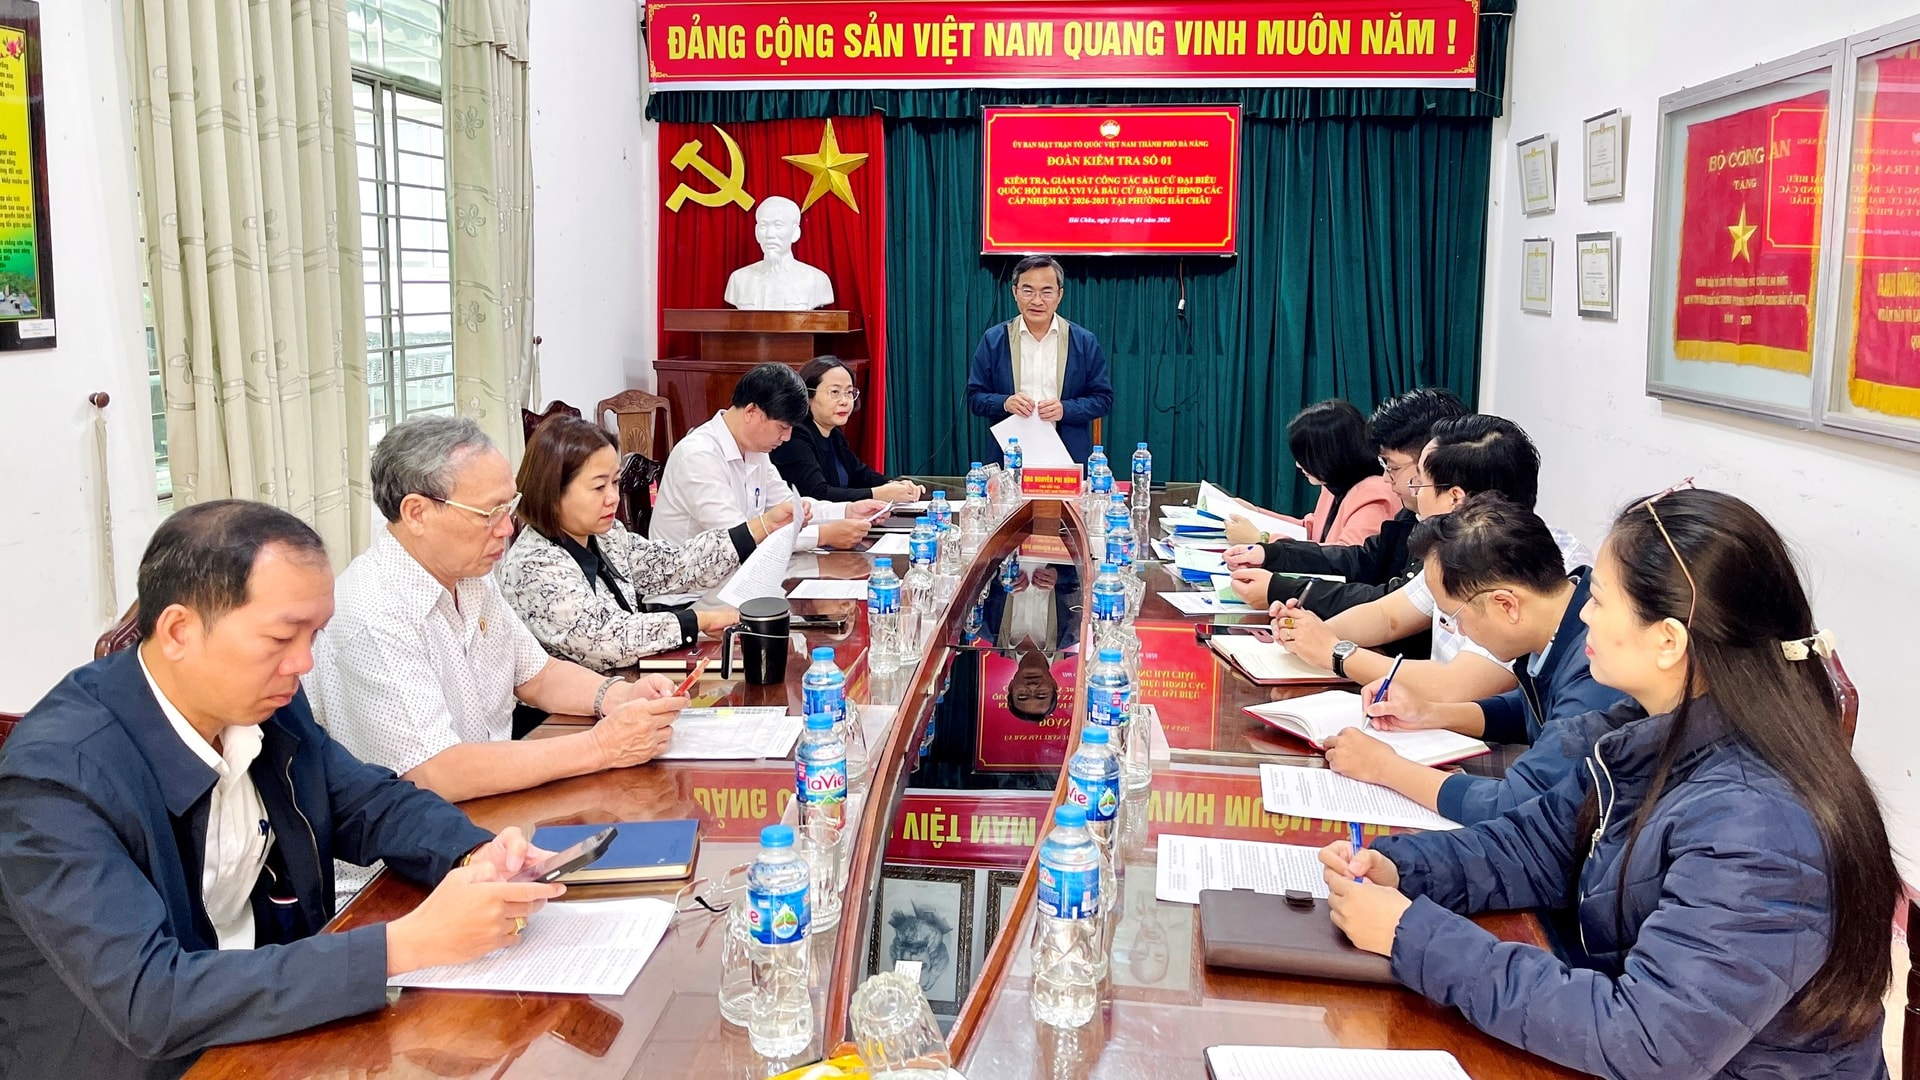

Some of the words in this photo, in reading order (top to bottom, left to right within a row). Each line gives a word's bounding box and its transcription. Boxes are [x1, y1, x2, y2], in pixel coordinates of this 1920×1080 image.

[667, 13, 746, 60] ĐẢNG
[755, 17, 834, 66] CỘNG
[844, 11, 904, 59] SẢN
[913, 15, 975, 65] VIỆT
[984, 22, 1053, 58] NAM
[1063, 20, 1165, 60] QUANG
[1174, 19, 1247, 56] VINH
[1256, 12, 1350, 56] MUÔN
[1360, 11, 1435, 56] NĂM
[1446, 18, 1457, 55] !
[1023, 141, 1037, 149] BAN
[1084, 140, 1103, 149] QUỐC
[1104, 140, 1120, 149] VIỆT
[1138, 140, 1162, 148] THÀNH
[1728, 145, 1765, 168] CÔNG
[1768, 139, 1791, 161] AN
[1047, 154, 1080, 166] ĐOÀN
[1083, 153, 1114, 166] KIỂM
[1117, 156, 1141, 166] TRA
[1142, 153, 1158, 166] SỐ
[1160, 156, 1172, 166] 01
[1004, 175, 1027, 185] KIỂM
[1029, 177, 1050, 185] TRA,
[1051, 176, 1075, 185] GIÁM
[1076, 176, 1093, 185] SÁT
[1095, 175, 1121, 184] CÔNG
[1122, 175, 1141, 184] TÁC
[1177, 176, 1194, 186] ĐẠI
[997, 186, 1023, 196] QUỐC
[1024, 186, 1041, 196] HỘI
[1042, 185, 1068, 195] KHÓA
[1069, 187, 1085, 195] XVI
[1087, 186, 1099, 195] VÀ
[1136, 187, 1152, 196] ĐẠI
[1203, 185, 1224, 194] CÁC
[1027, 197, 1056, 206] NHIỆM
[1072, 197, 1109, 205] 2026-2031
[1111, 197, 1126, 206] TẠI
[1128, 195, 1166, 205] PHƯỜNG
[1168, 195, 1184, 204] HẢI
[1185, 195, 1212, 204] CHÂU
